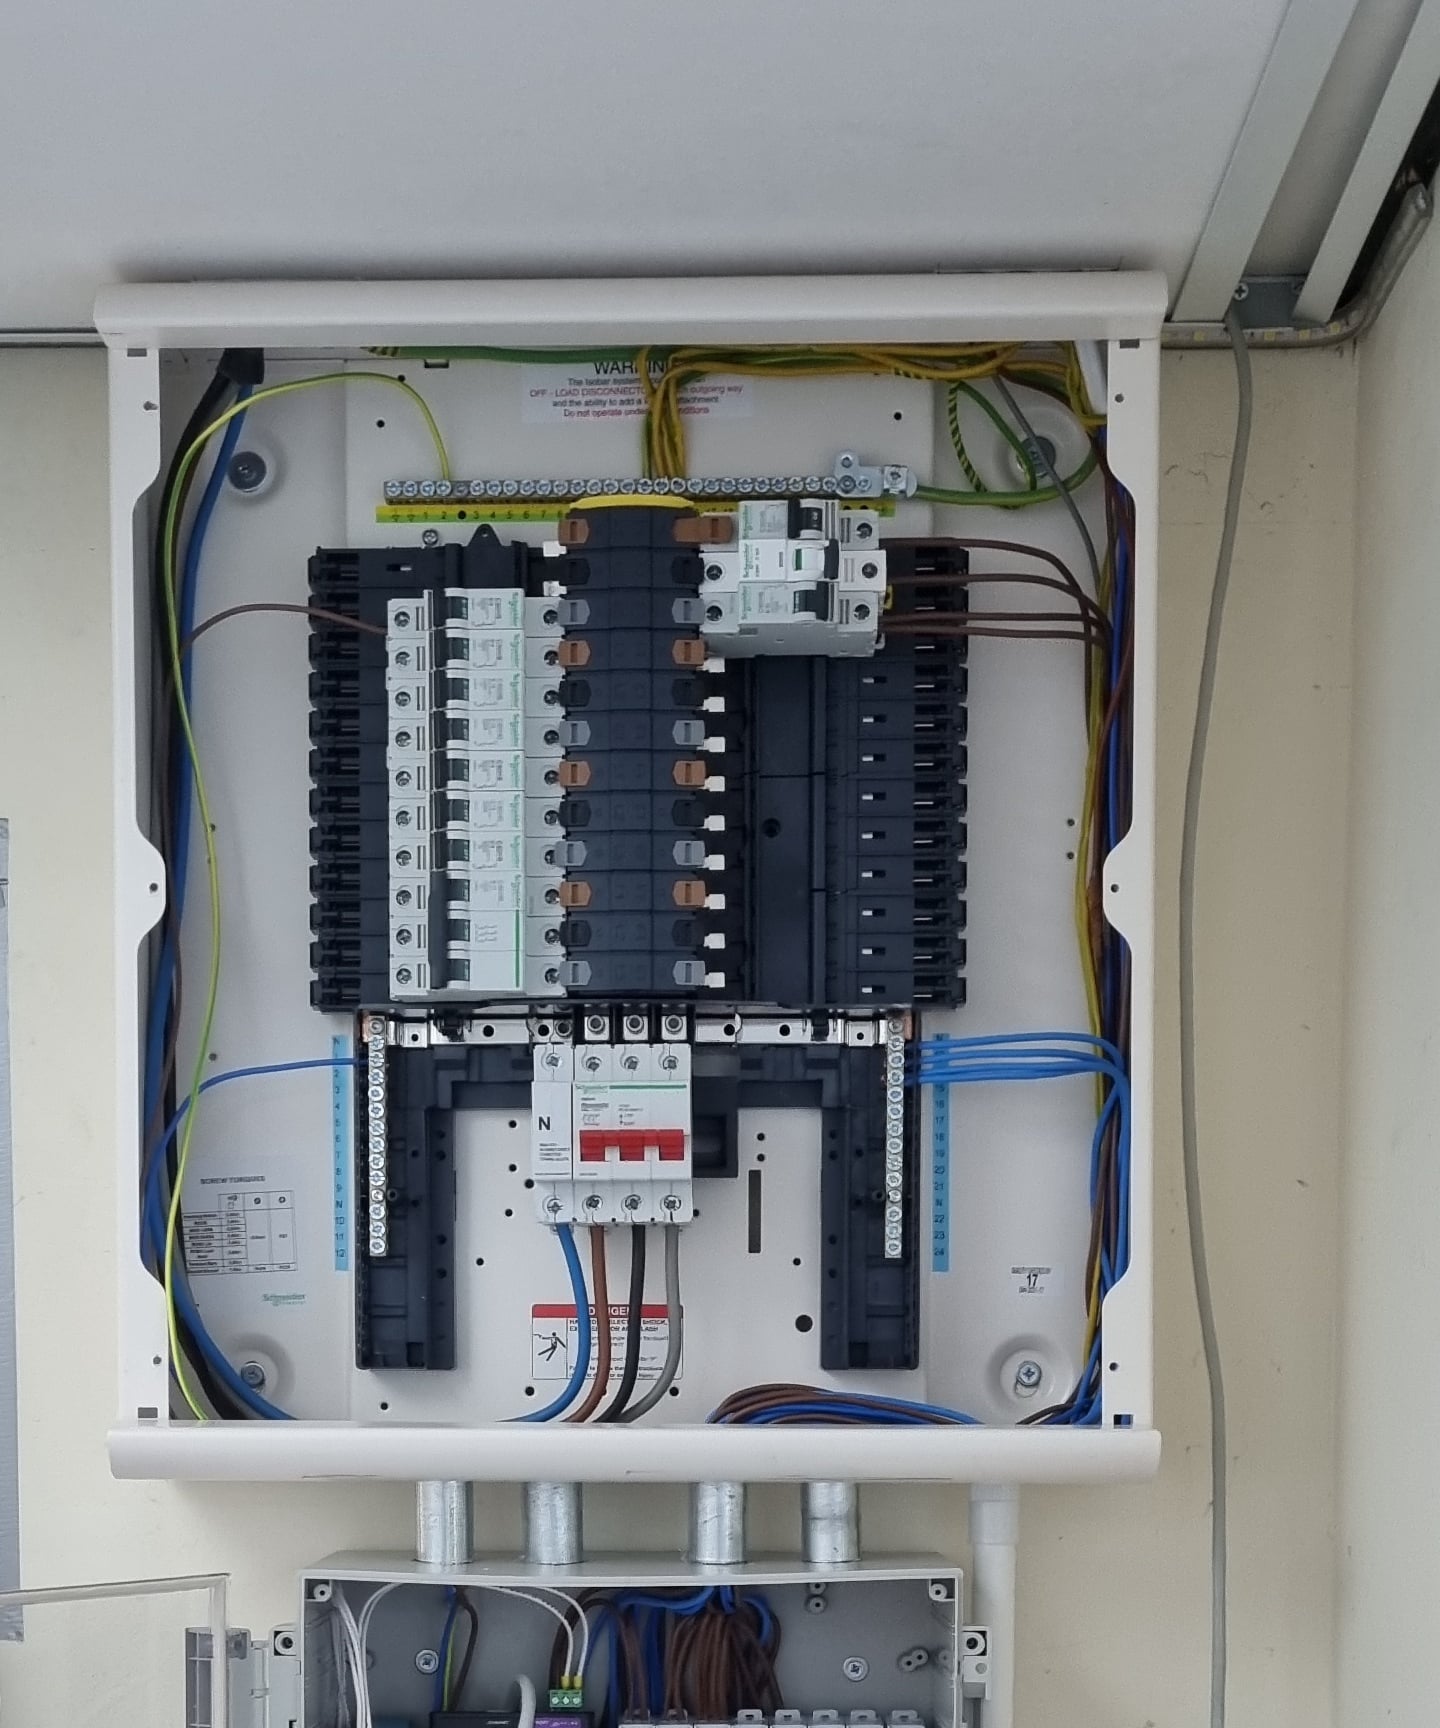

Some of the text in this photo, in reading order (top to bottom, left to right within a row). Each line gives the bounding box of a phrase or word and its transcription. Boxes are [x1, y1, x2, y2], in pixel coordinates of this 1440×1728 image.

[529, 389, 548, 398] OFF
[555, 388, 580, 398] LOAD
[581, 386, 647, 397] DISCONNECTO
[618, 398, 635, 406] add
[564, 408, 575, 417] Do
[576, 409, 591, 417] not
[538, 1116, 551, 1131] N
[1026, 1273, 1039, 1287] 17
